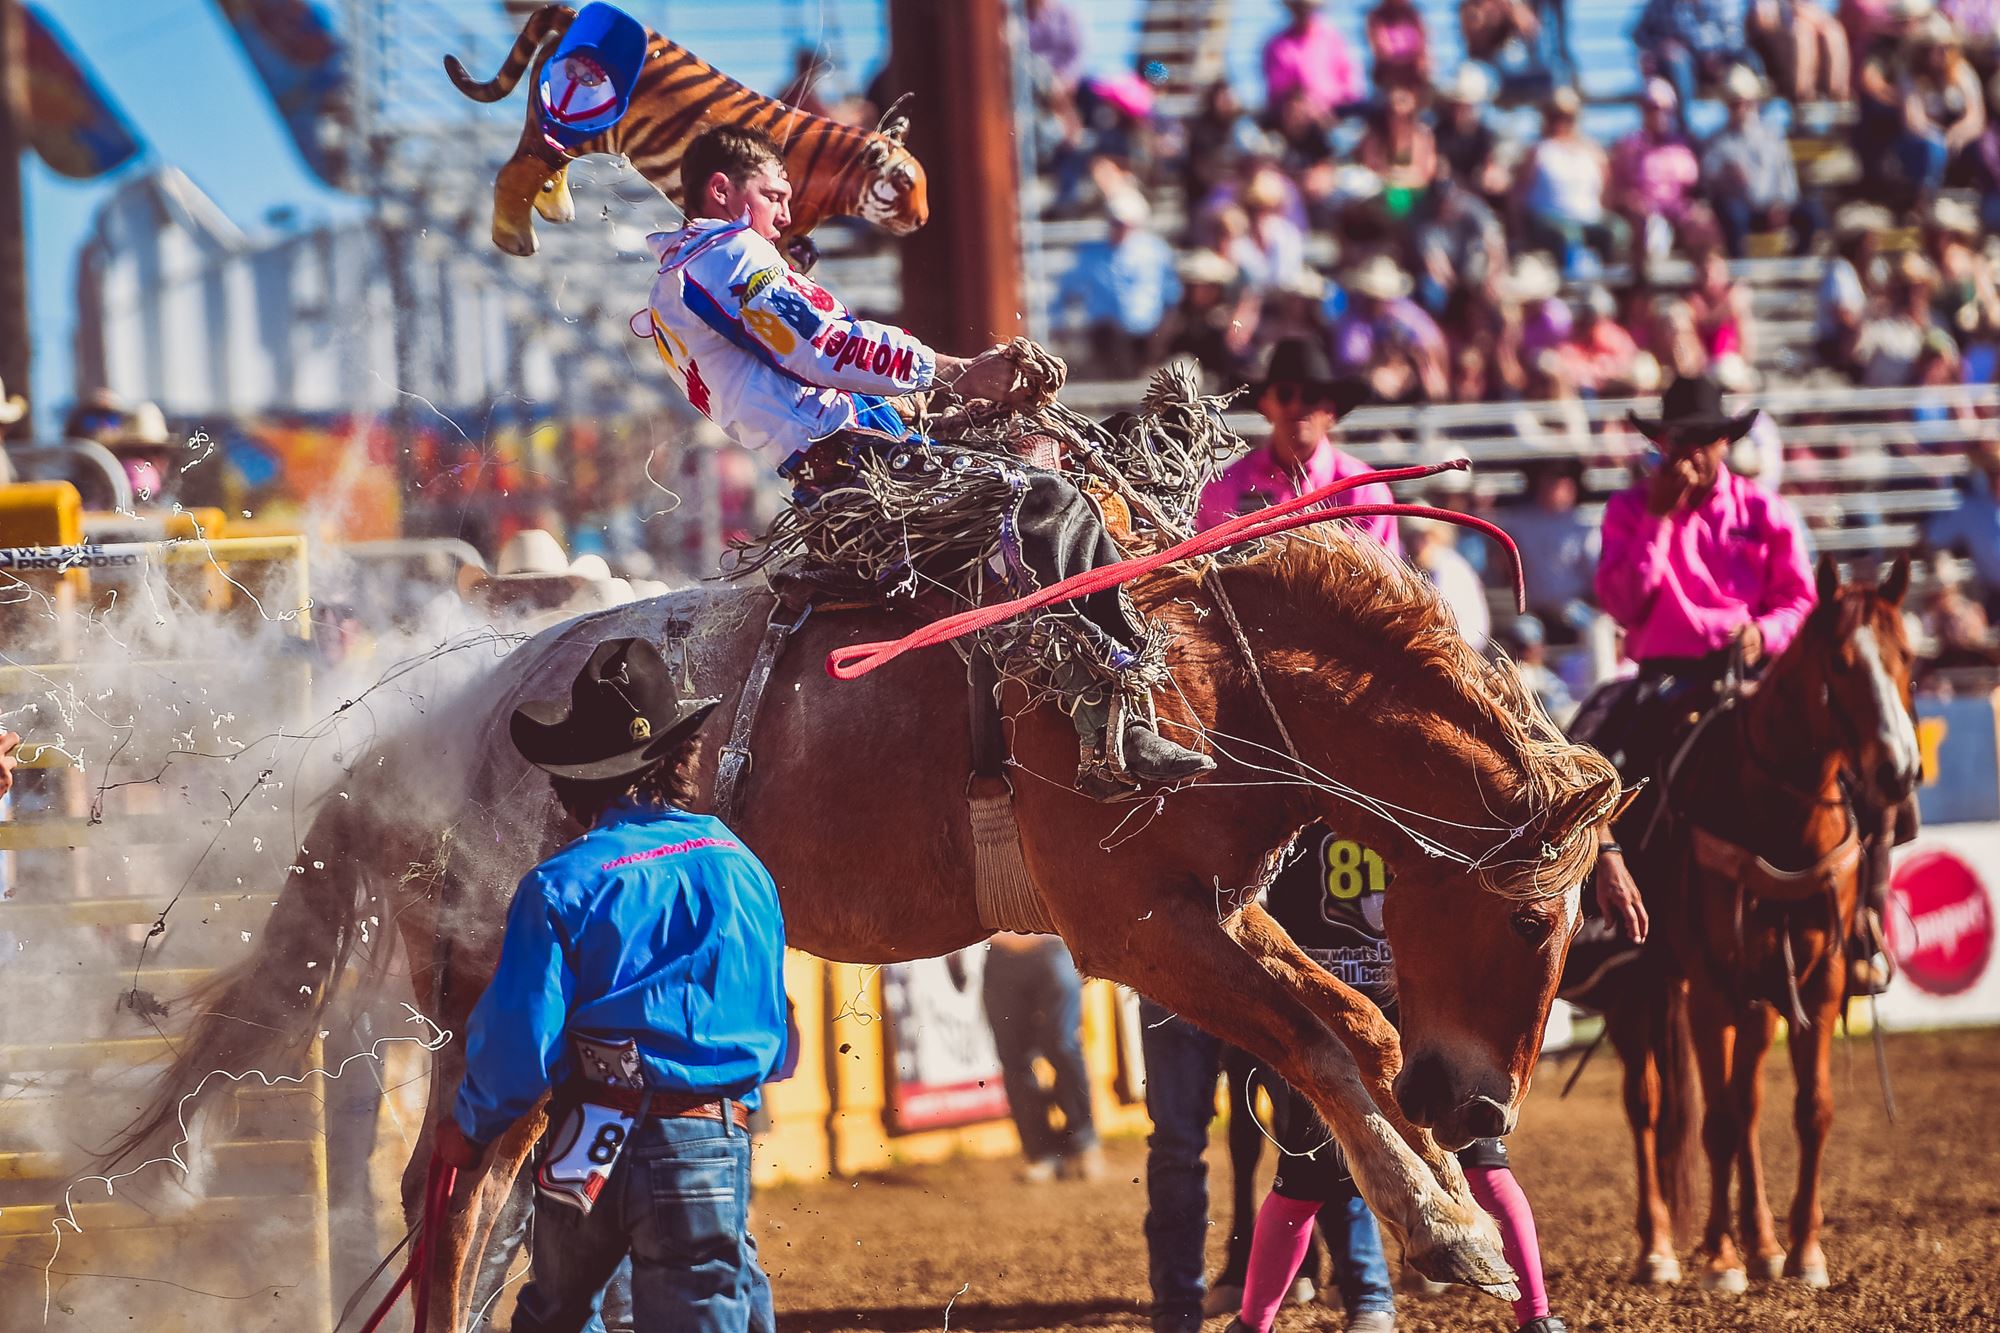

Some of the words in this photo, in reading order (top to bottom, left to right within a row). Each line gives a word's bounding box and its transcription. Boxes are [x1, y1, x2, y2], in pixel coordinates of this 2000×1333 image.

[810, 323, 914, 382] Wonder
[17, 546, 53, 558] WE
[60, 543, 104, 556] ARE
[1328, 839, 1386, 899] 81
[587, 1121, 626, 1166] 8
